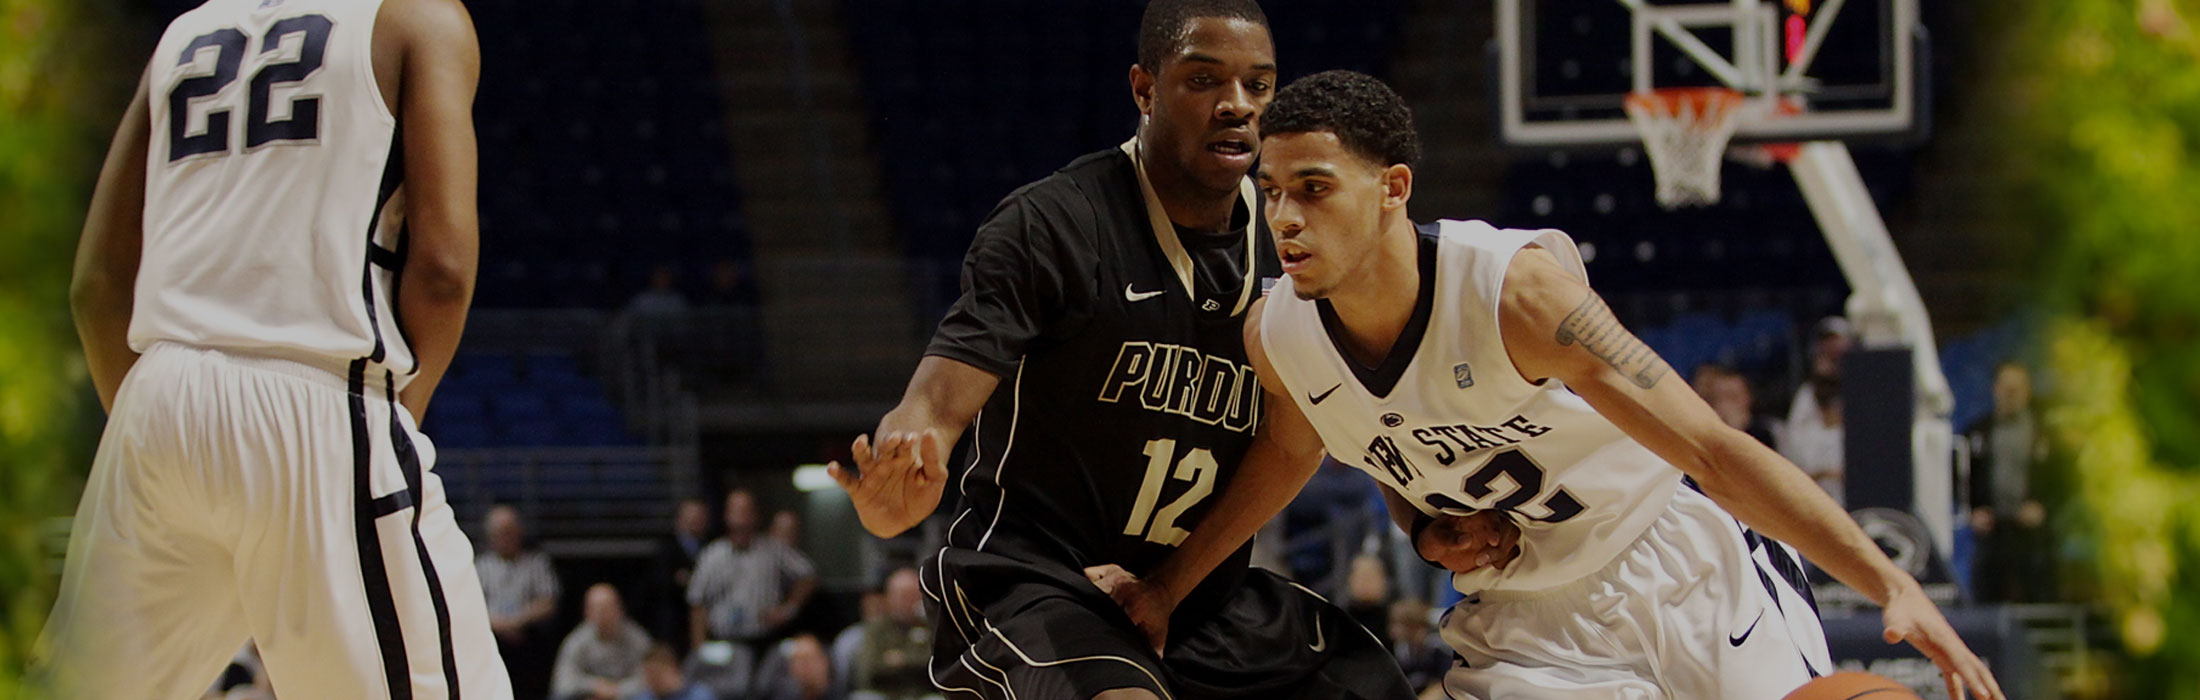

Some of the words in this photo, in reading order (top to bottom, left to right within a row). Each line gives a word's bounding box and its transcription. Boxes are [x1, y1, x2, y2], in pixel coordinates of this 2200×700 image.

[168, 13, 337, 167] 22
[1201, 298, 1221, 312] P
[1098, 341, 1261, 436] PURDU
[1411, 414, 1553, 467] STATE
[1122, 438, 1219, 548] 12
